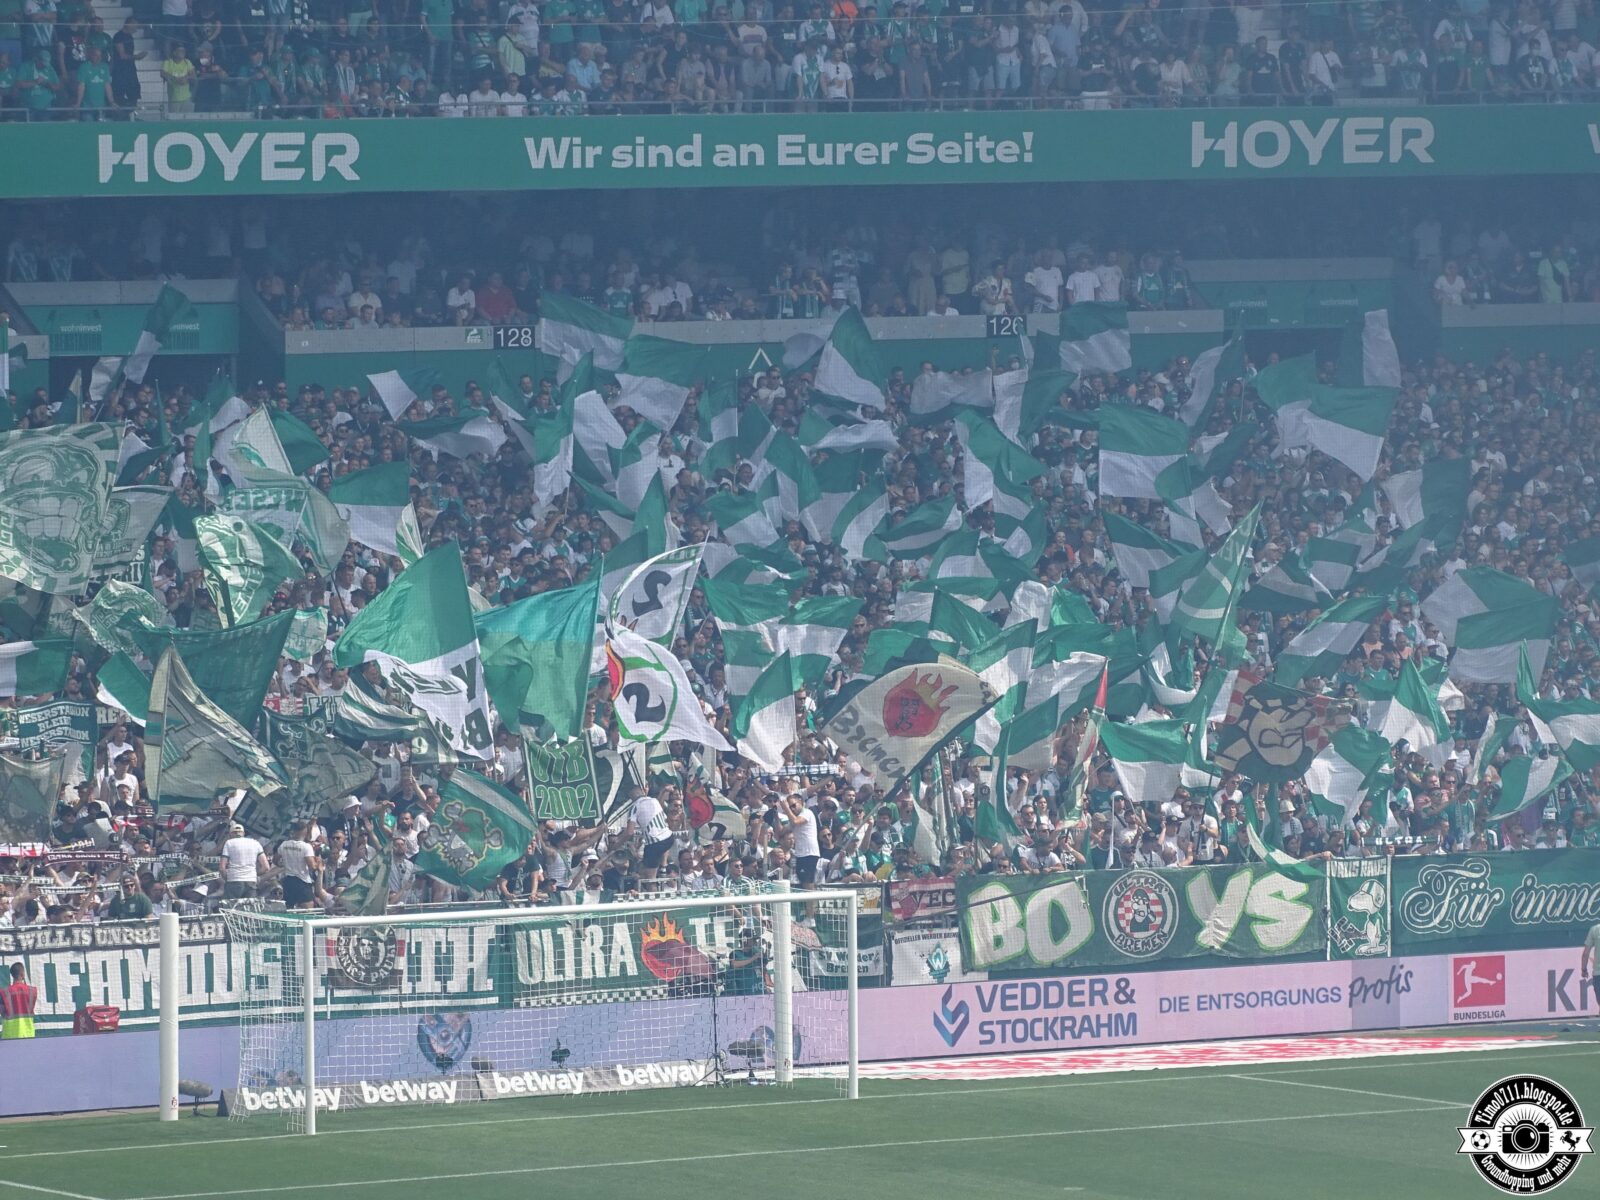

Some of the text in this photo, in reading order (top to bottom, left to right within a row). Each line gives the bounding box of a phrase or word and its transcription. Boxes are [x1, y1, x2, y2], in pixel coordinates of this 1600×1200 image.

[98, 131, 361, 183] HOYER
[524, 131, 1034, 170] Wir sind an Eurer Seite!
[1192, 117, 1435, 168] HOYER
[496, 327, 532, 347] 128
[989, 316, 1024, 335] 126
[622, 682, 666, 724] 2
[535, 783, 597, 820] 2002
[1402, 859, 1503, 932] Für
[18, 927, 71, 950] WILL
[73, 926, 92, 946] IS
[1114, 929, 1168, 952] BREMEN
[514, 921, 639, 985] ULTRA
[975, 977, 1136, 1013] VEDDER &
[1159, 985, 1342, 1014] DIE ENTSORGUNGS
[978, 1011, 1138, 1045] STOCKRAHM
[1453, 1010, 1506, 1021] BUNDESLIGA
[493, 1071, 584, 1095] betway
[616, 1063, 705, 1087] betway
[241, 1086, 342, 1111] betway
[359, 1080, 458, 1104] betway
